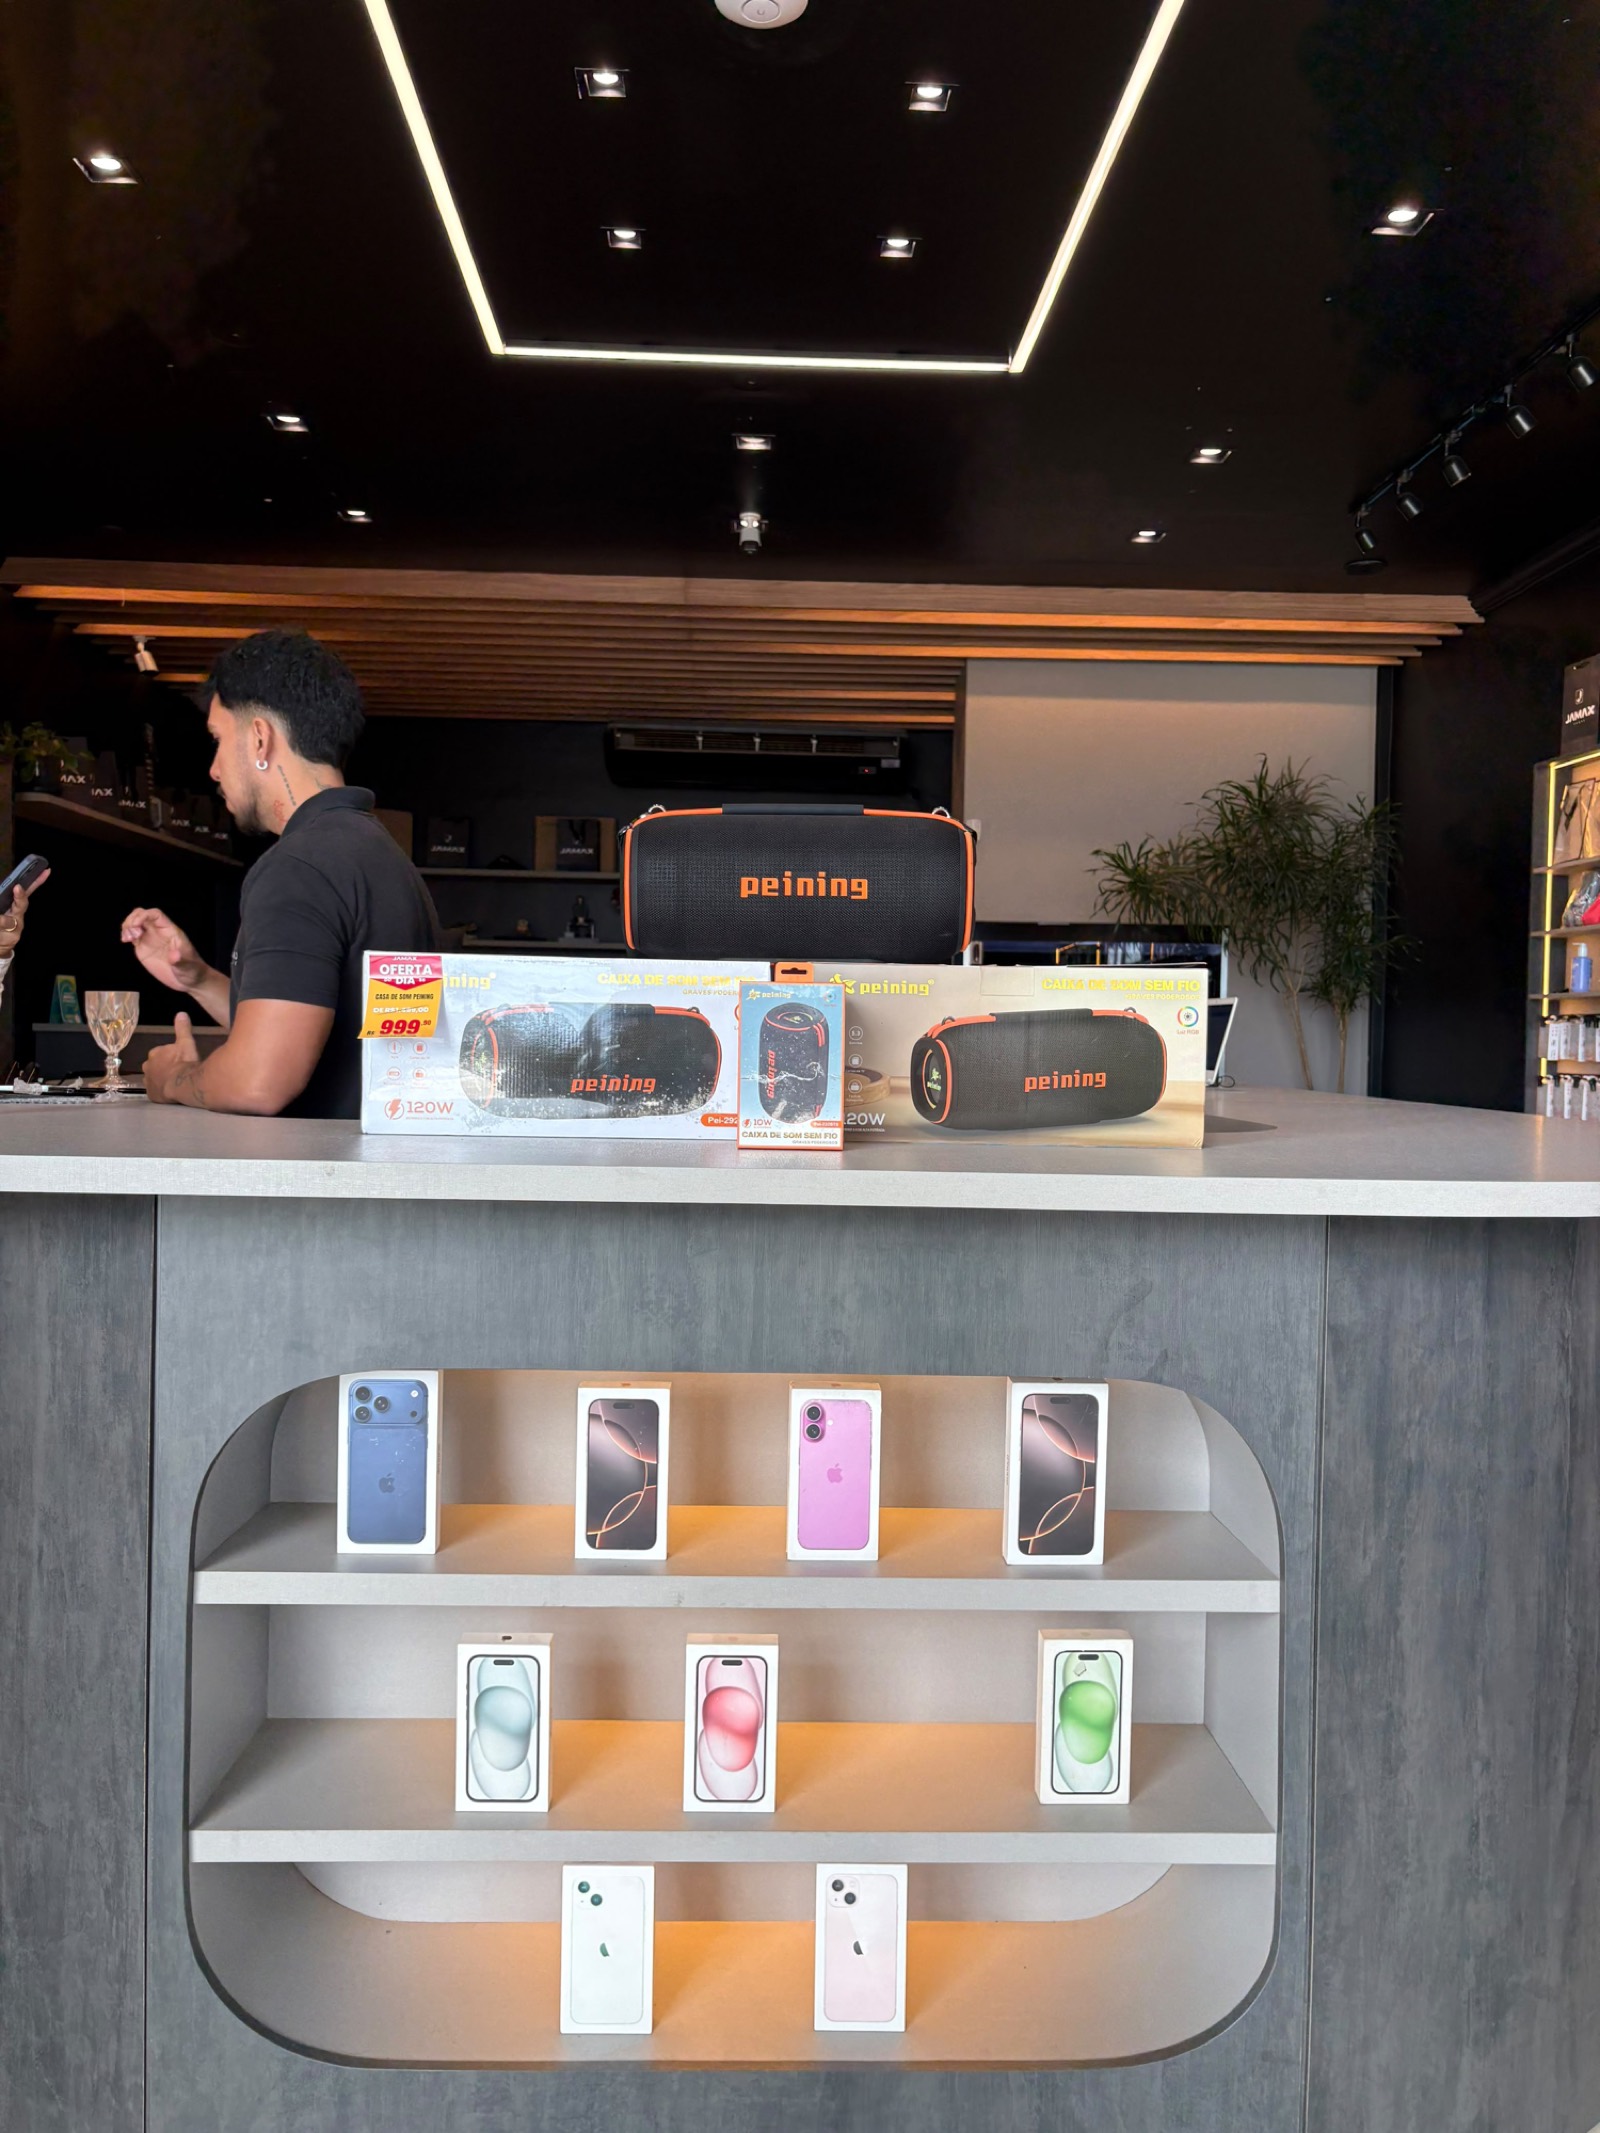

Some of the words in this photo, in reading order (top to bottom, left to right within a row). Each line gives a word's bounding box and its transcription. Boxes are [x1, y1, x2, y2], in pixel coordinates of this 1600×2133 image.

[1565, 705, 1596, 725] JAMAX
[740, 871, 868, 900] peining
[379, 964, 433, 976] OFERTA
[396, 976, 415, 985] DIA
[443, 973, 491, 990] ining
[597, 973, 642, 986] CAIXA
[644, 974, 664, 986] DE
[667, 975, 699, 987] SOM
[702, 976, 732, 988] SEM
[860, 979, 930, 996] peining
[1041, 978, 1086, 991] CAIXA
[1088, 979, 1106, 991] DE
[1110, 979, 1142, 991] SOM
[1144, 979, 1174, 992] SEM
[1177, 980, 1200, 992] FIO
[379, 1019, 421, 1035] 999
[570, 1074, 656, 1093] peining
[1024, 1069, 1107, 1093] peining
[407, 1101, 454, 1114] 120W
[753, 1118, 772, 1126] 10W
[844, 1112, 886, 1126] 20W
[741, 1131, 768, 1139] CAIXA
[769, 1131, 781, 1139] DE
[823, 1132, 838, 1140] FIO
